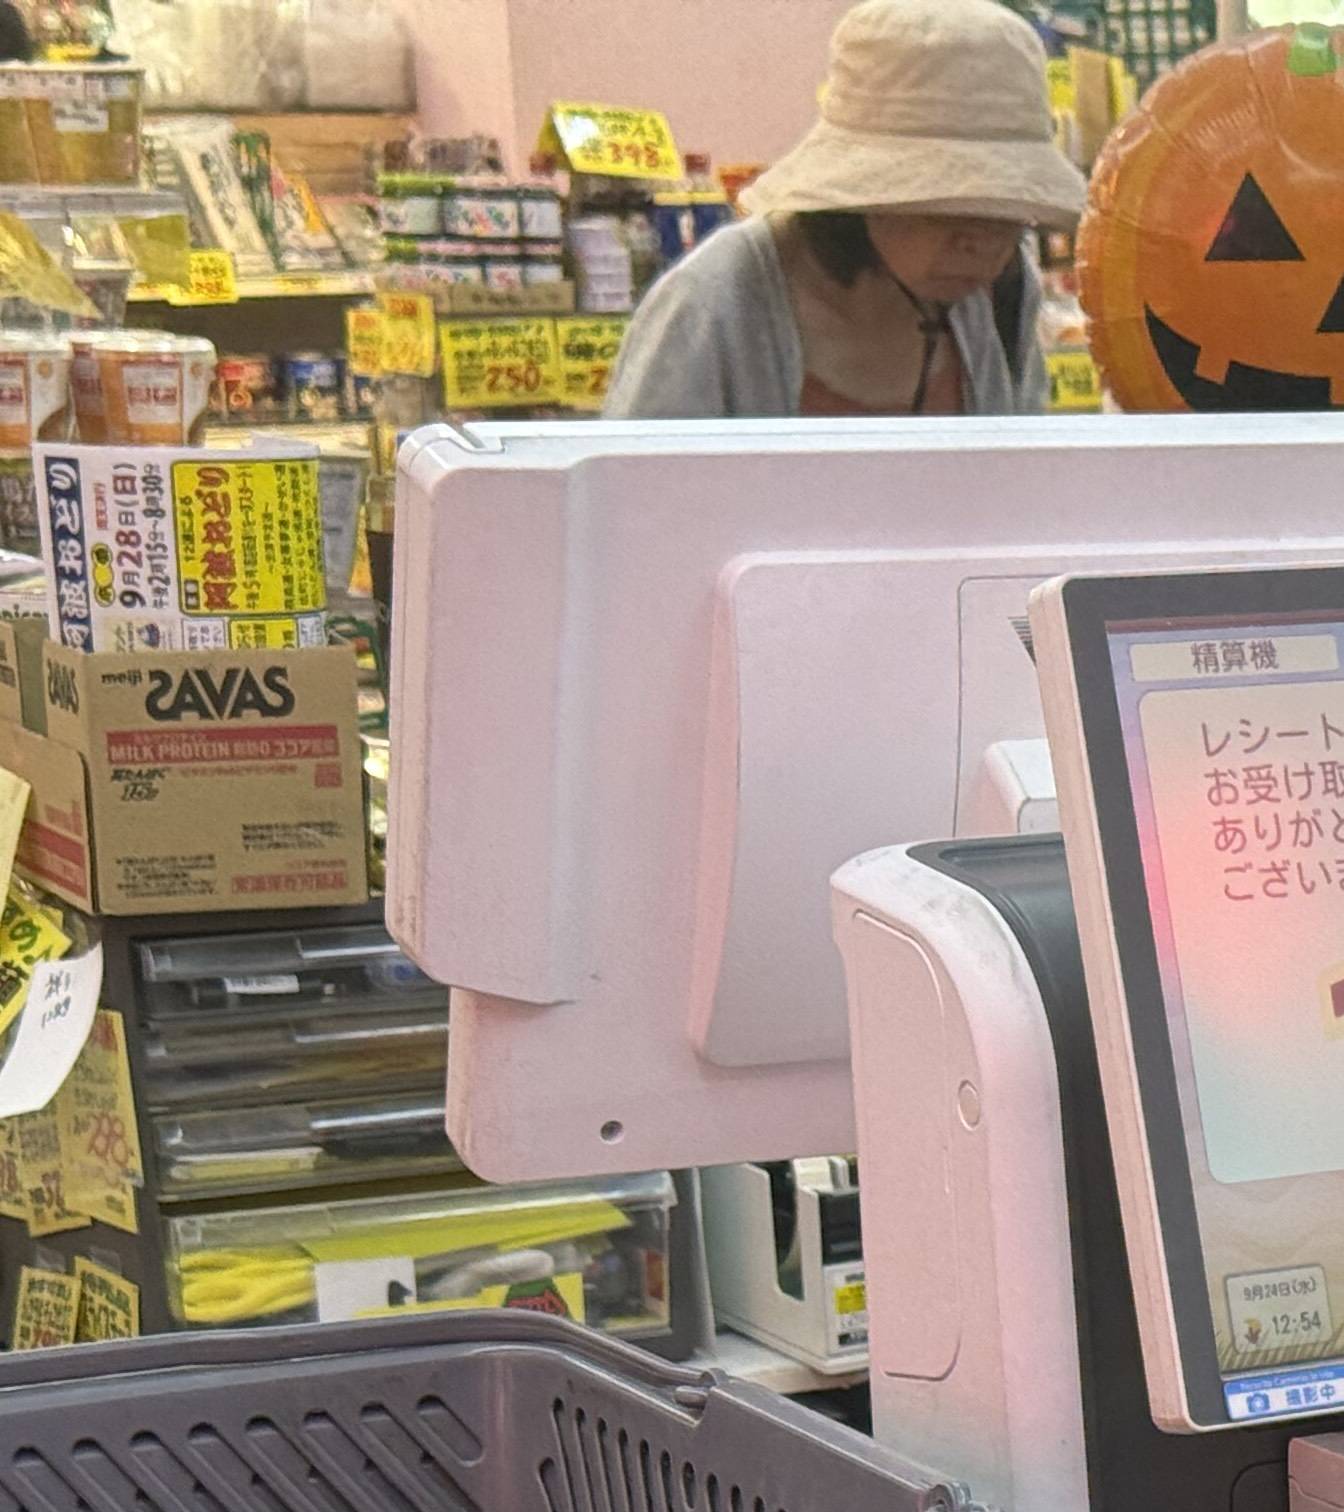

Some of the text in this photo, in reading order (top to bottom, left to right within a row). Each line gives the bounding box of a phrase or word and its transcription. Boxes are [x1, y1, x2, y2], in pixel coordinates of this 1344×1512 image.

[112, 462, 147, 609] 9月28日(日)
[1190, 640, 1280, 675] 精算機
[102, 666, 296, 721] meiji SAVAS
[110, 744, 156, 762] MILK
[158, 741, 231, 760] PROTEIN
[1272, 1311, 1323, 1337] 12:54
